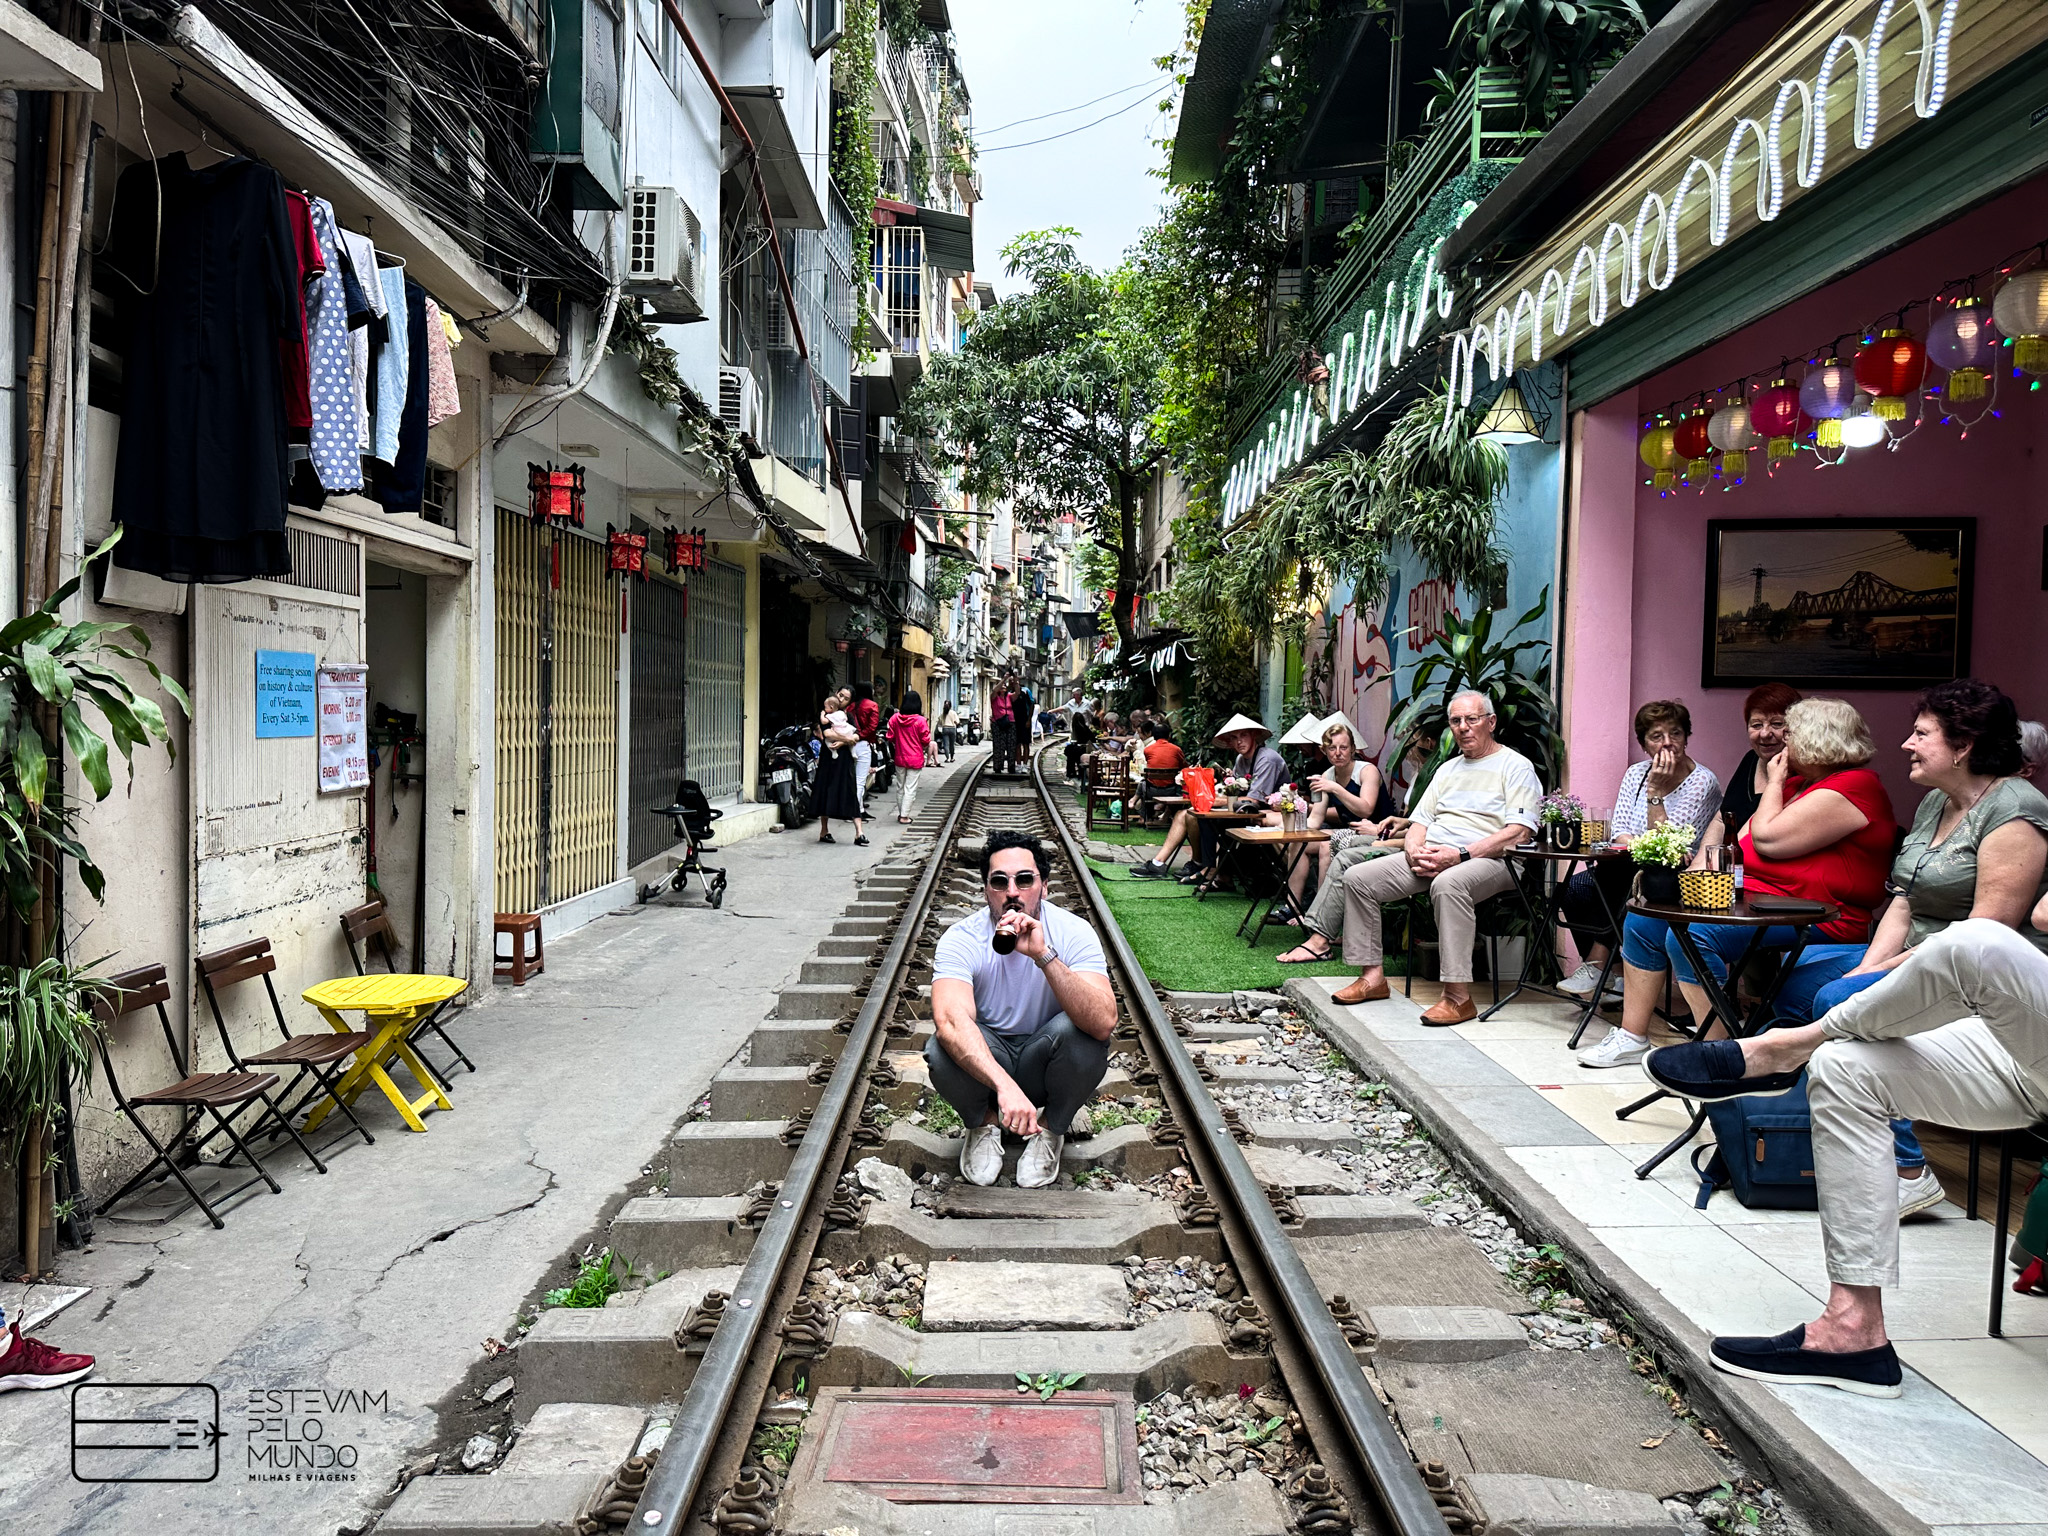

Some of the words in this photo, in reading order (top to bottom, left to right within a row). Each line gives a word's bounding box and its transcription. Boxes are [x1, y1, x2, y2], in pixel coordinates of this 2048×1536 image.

[260, 664, 272, 675] Free
[274, 665, 294, 679] sharing
[259, 683, 266, 691] on
[267, 680, 286, 694] history
[287, 681, 293, 692] &
[294, 682, 313, 692] culture
[270, 697, 276, 708] of
[277, 697, 303, 709] Vietnam,
[323, 704, 342, 715] MORNING
[262, 713, 279, 726] Every
[280, 713, 290, 724] Sat
[323, 766, 340, 778] EVENING
